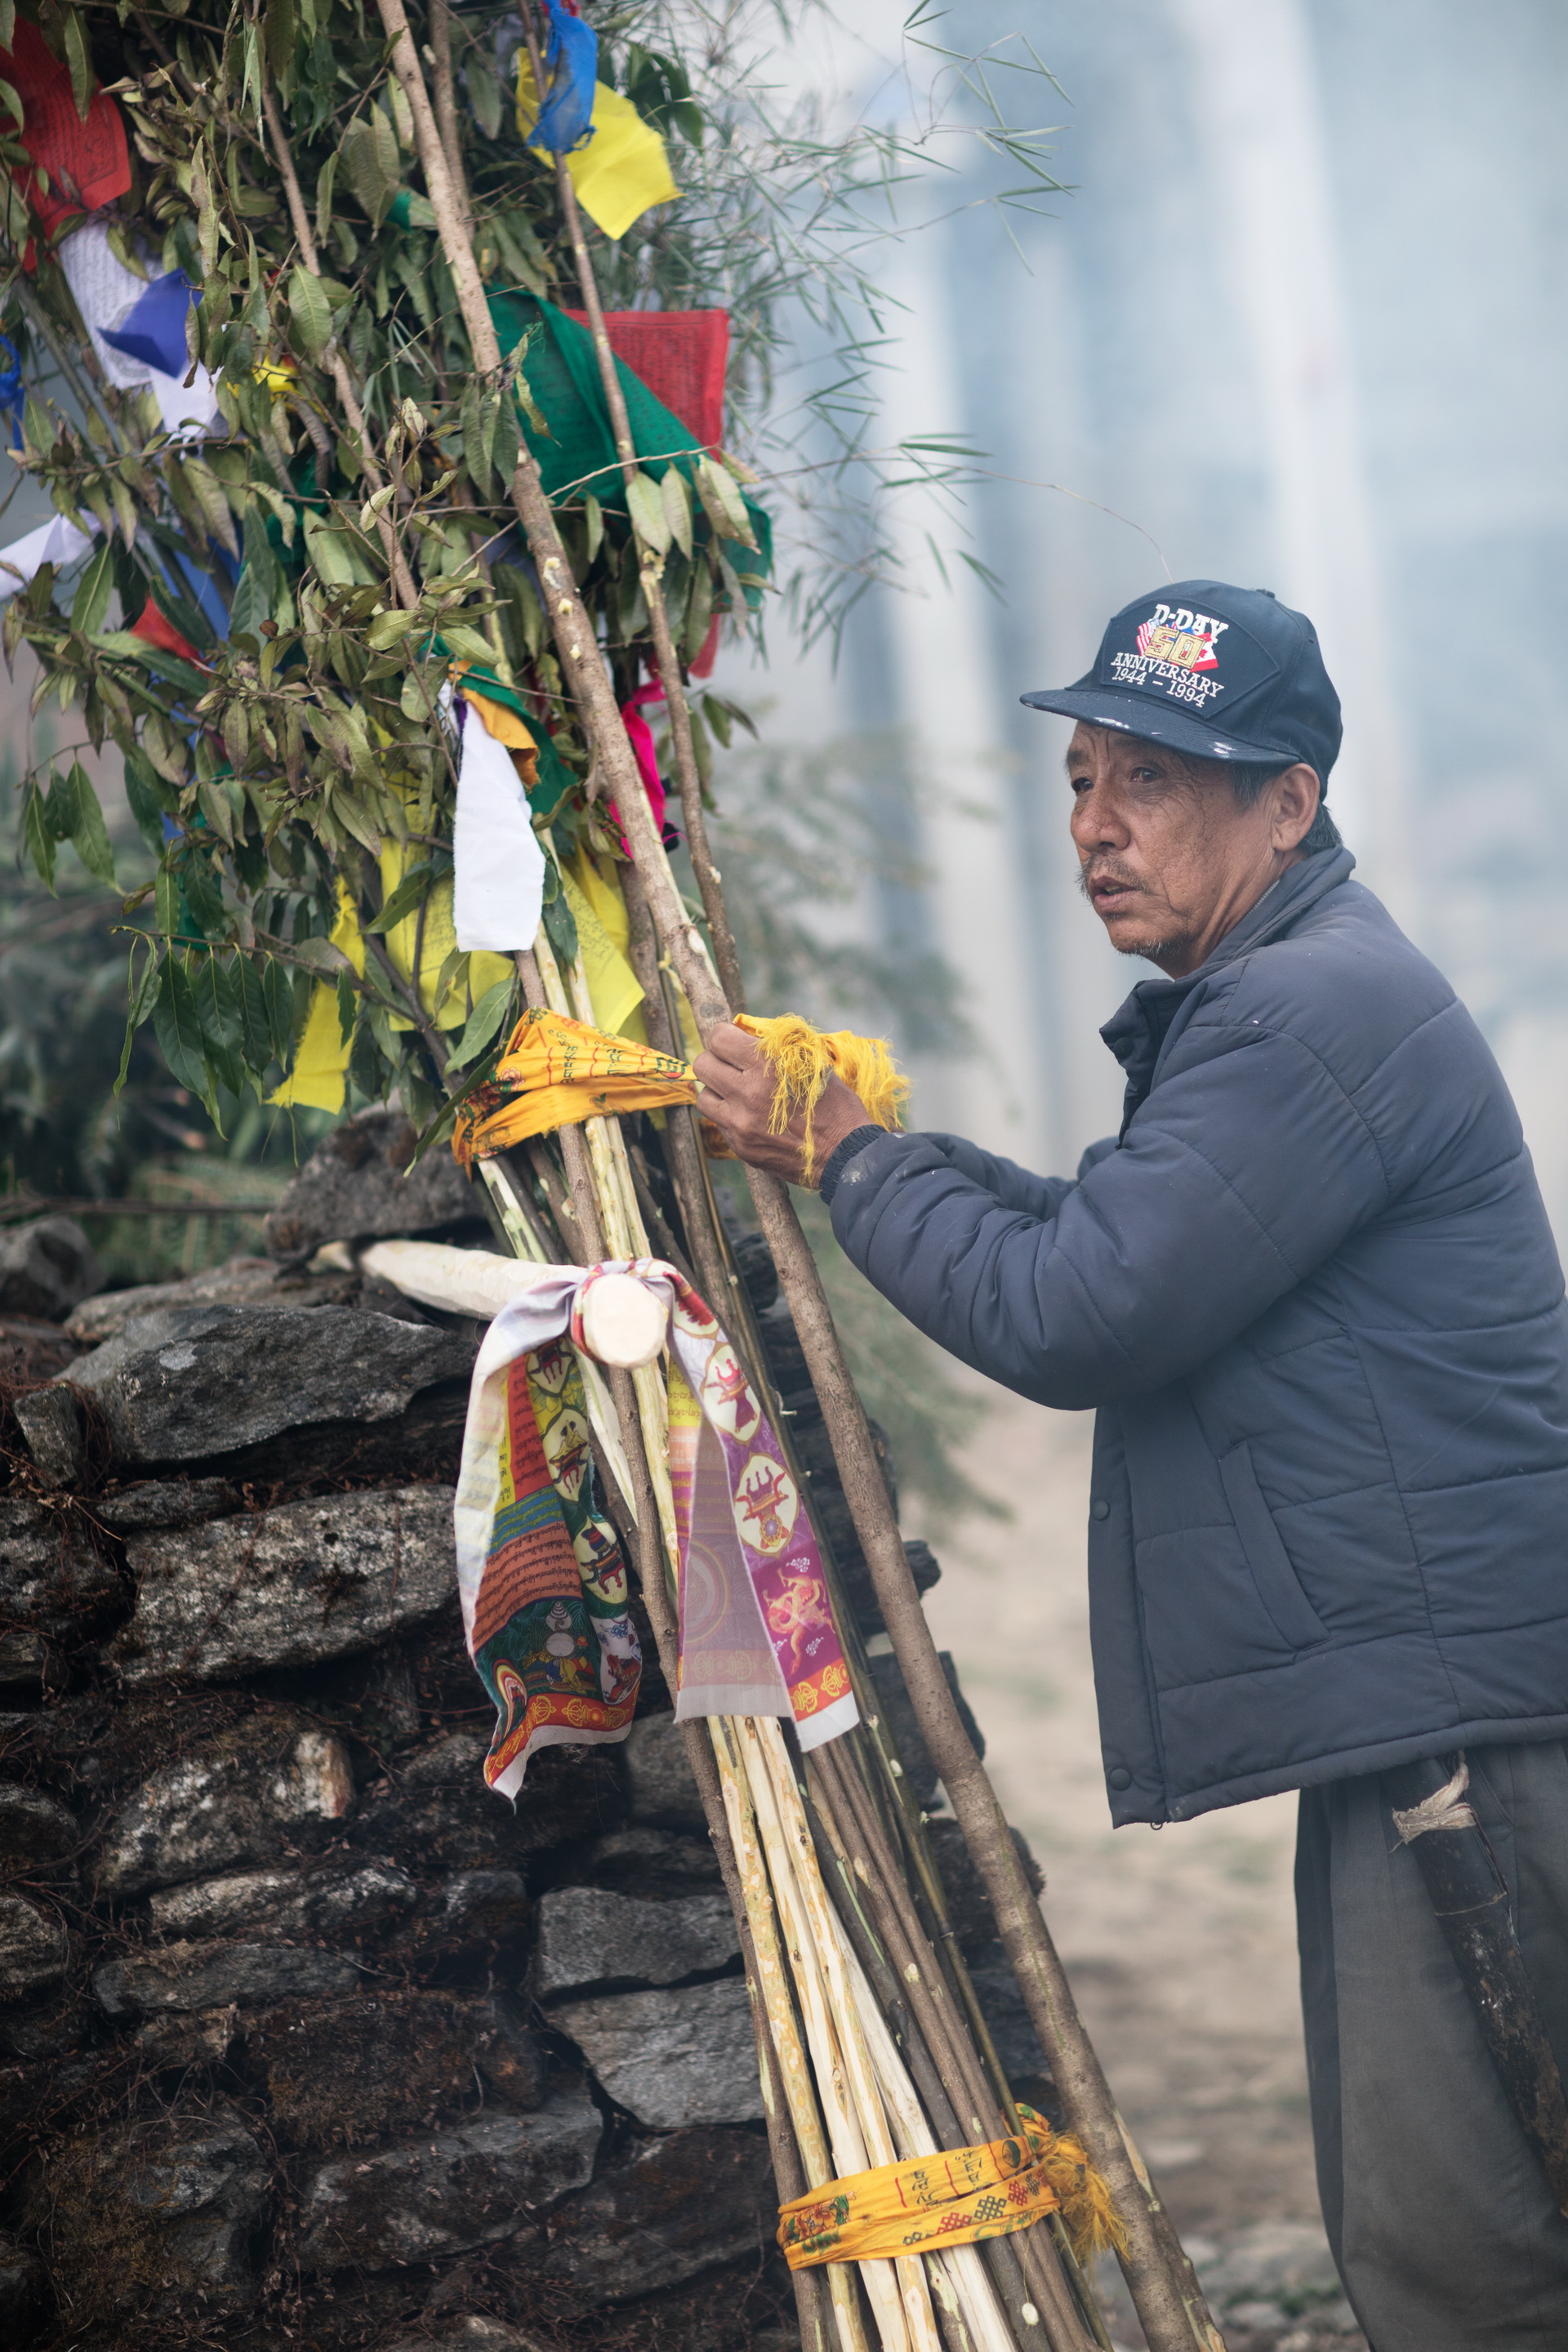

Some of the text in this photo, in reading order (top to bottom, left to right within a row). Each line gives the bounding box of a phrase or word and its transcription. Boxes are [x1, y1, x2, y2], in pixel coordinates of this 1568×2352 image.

[1147, 604, 1229, 644] D-DAY
[1144, 626, 1207, 670] 50
[1111, 653, 1224, 697] ANNIVERSARY
[1111, 666, 1147, 685] 1944
[1166, 680, 1206, 708] 1994
